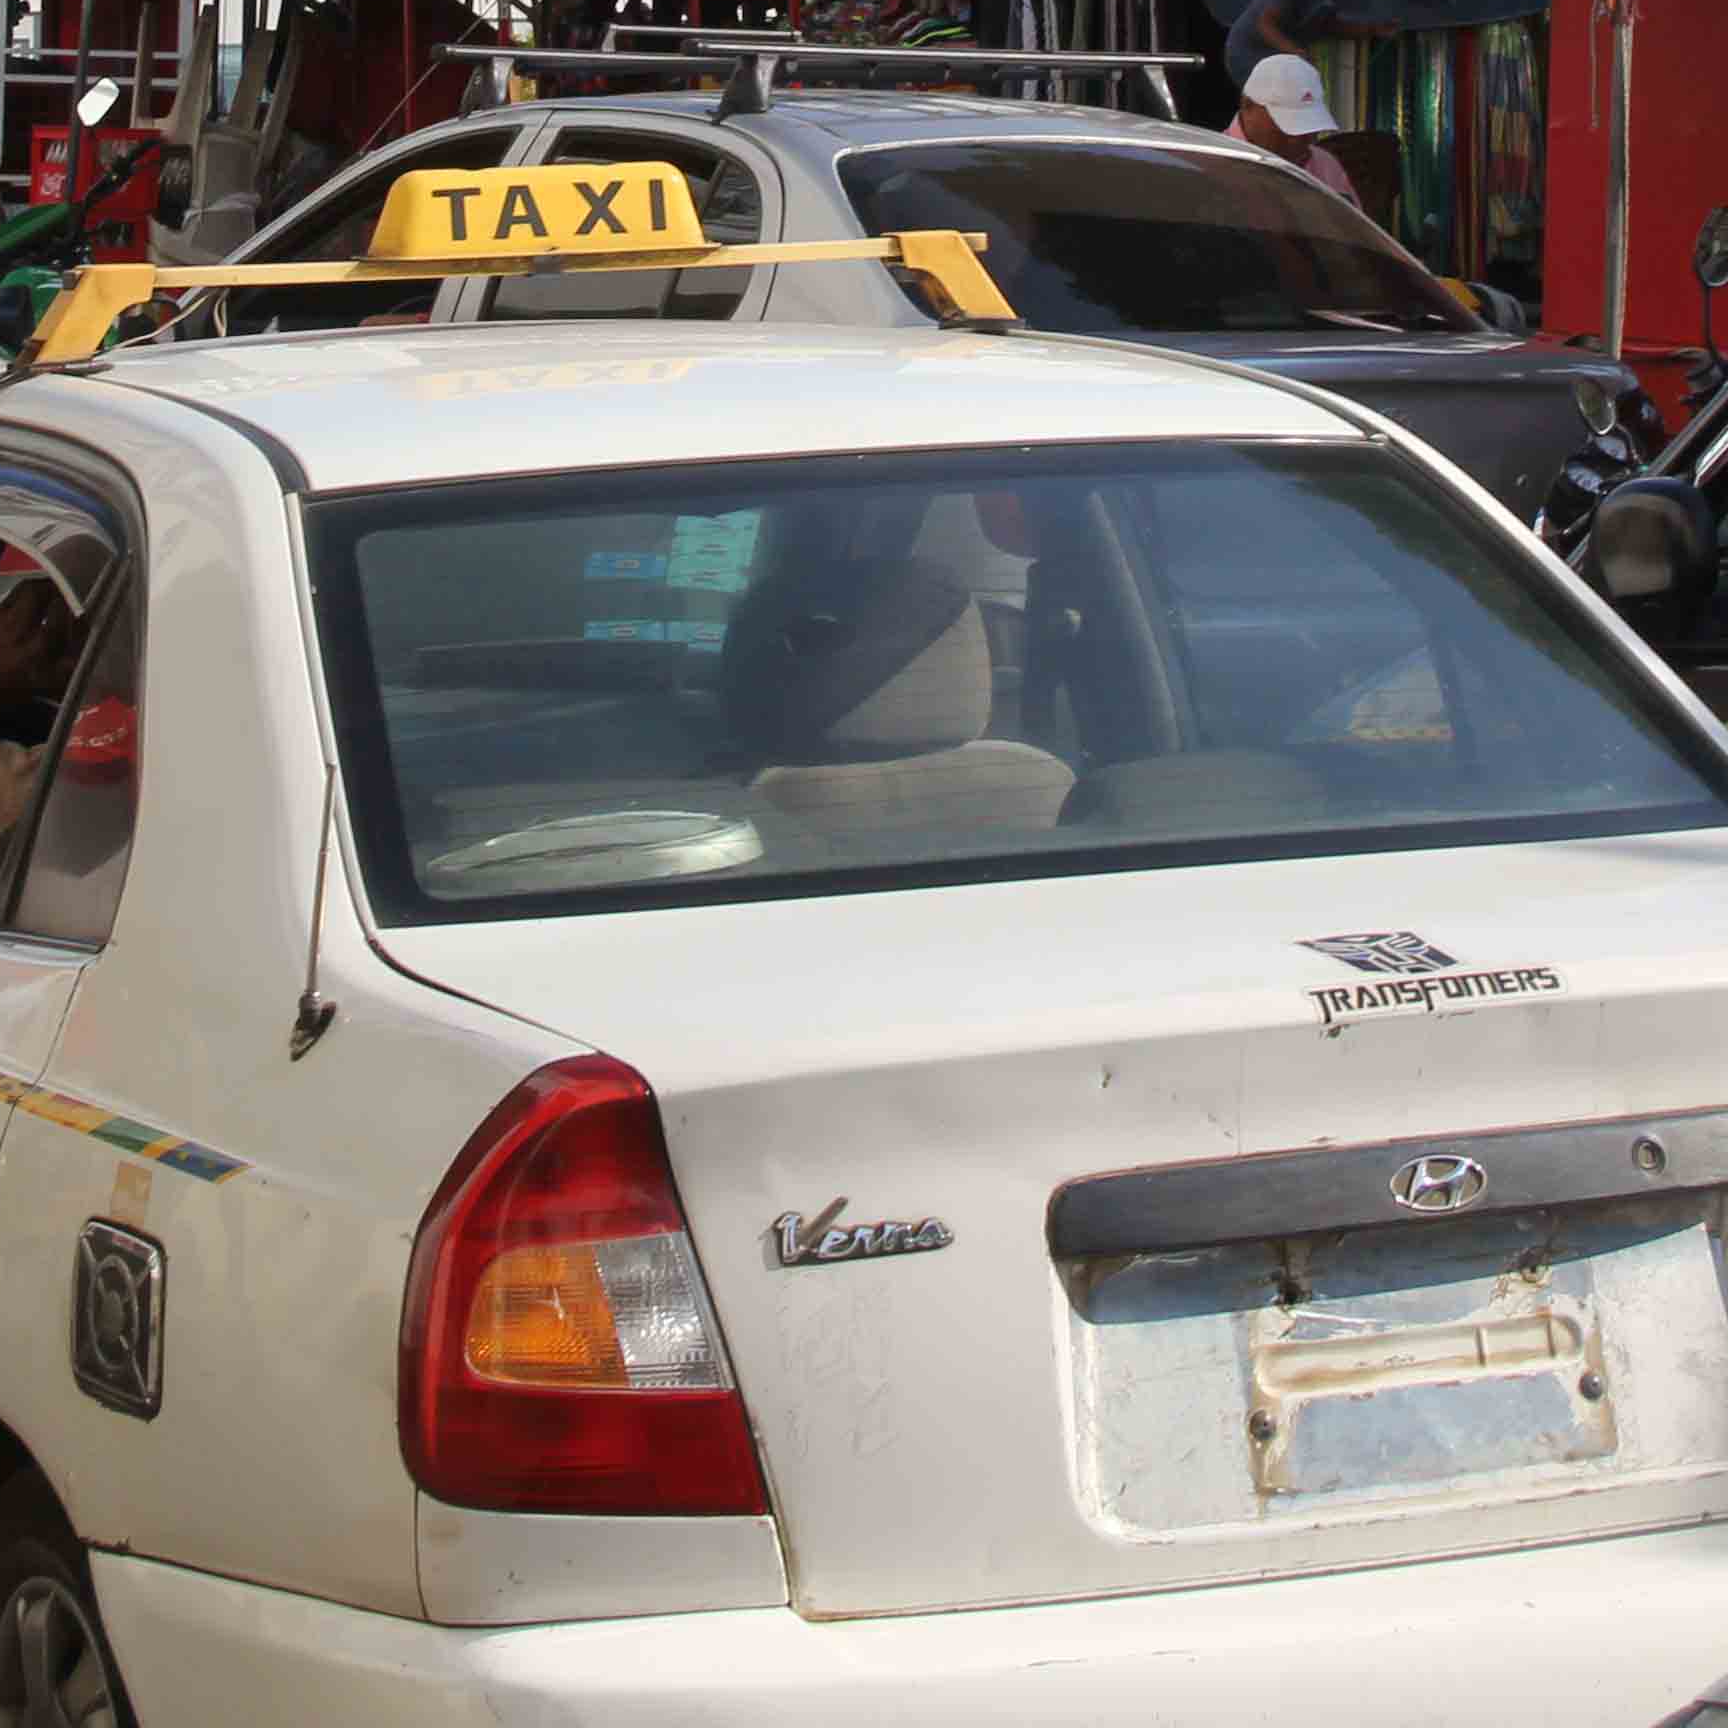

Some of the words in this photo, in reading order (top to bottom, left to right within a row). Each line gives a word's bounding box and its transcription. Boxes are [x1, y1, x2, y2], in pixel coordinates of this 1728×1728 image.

[432, 179, 666, 243] TAXI
[1308, 967, 1561, 1025] TRANSFOMERS
[771, 1195, 956, 1264] Verna
